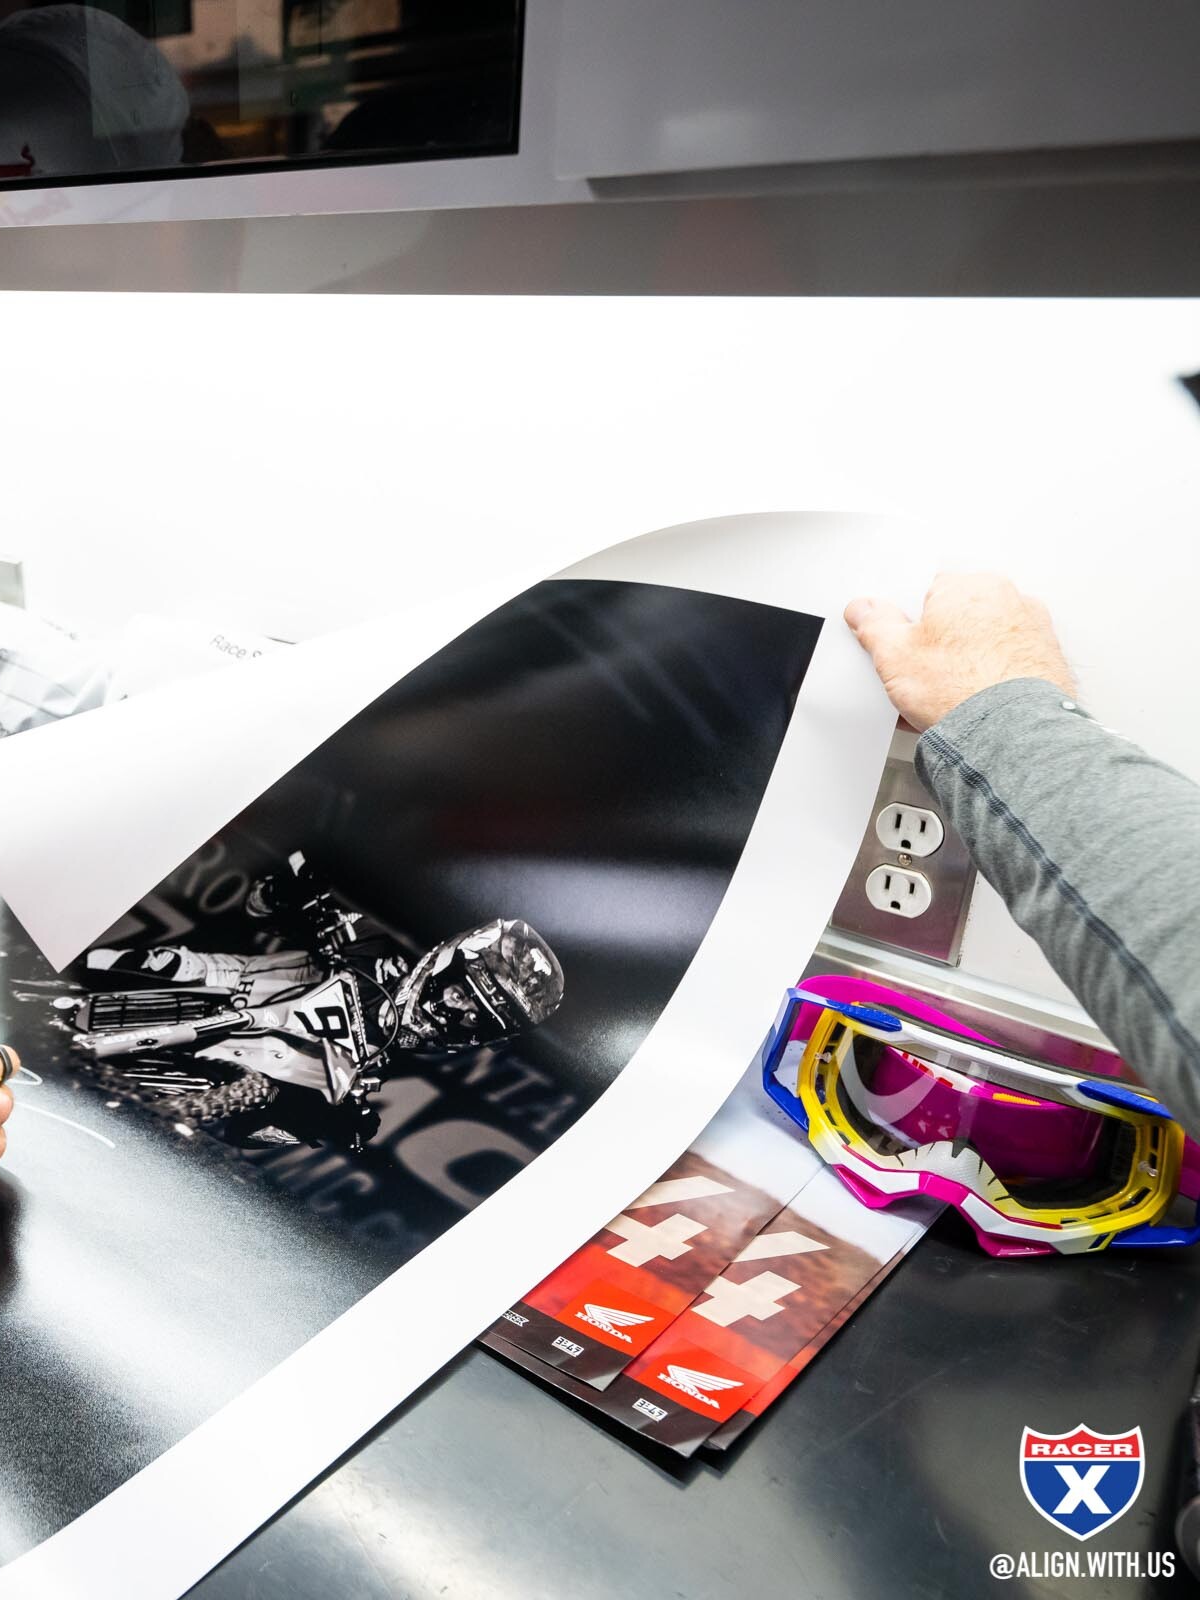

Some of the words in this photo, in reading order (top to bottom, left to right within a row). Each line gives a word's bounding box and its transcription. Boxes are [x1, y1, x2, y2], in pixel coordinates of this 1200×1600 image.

[208, 633, 247, 660] Race
[575, 1311, 633, 1344] HONDA
[657, 1373, 721, 1410] HONDA
